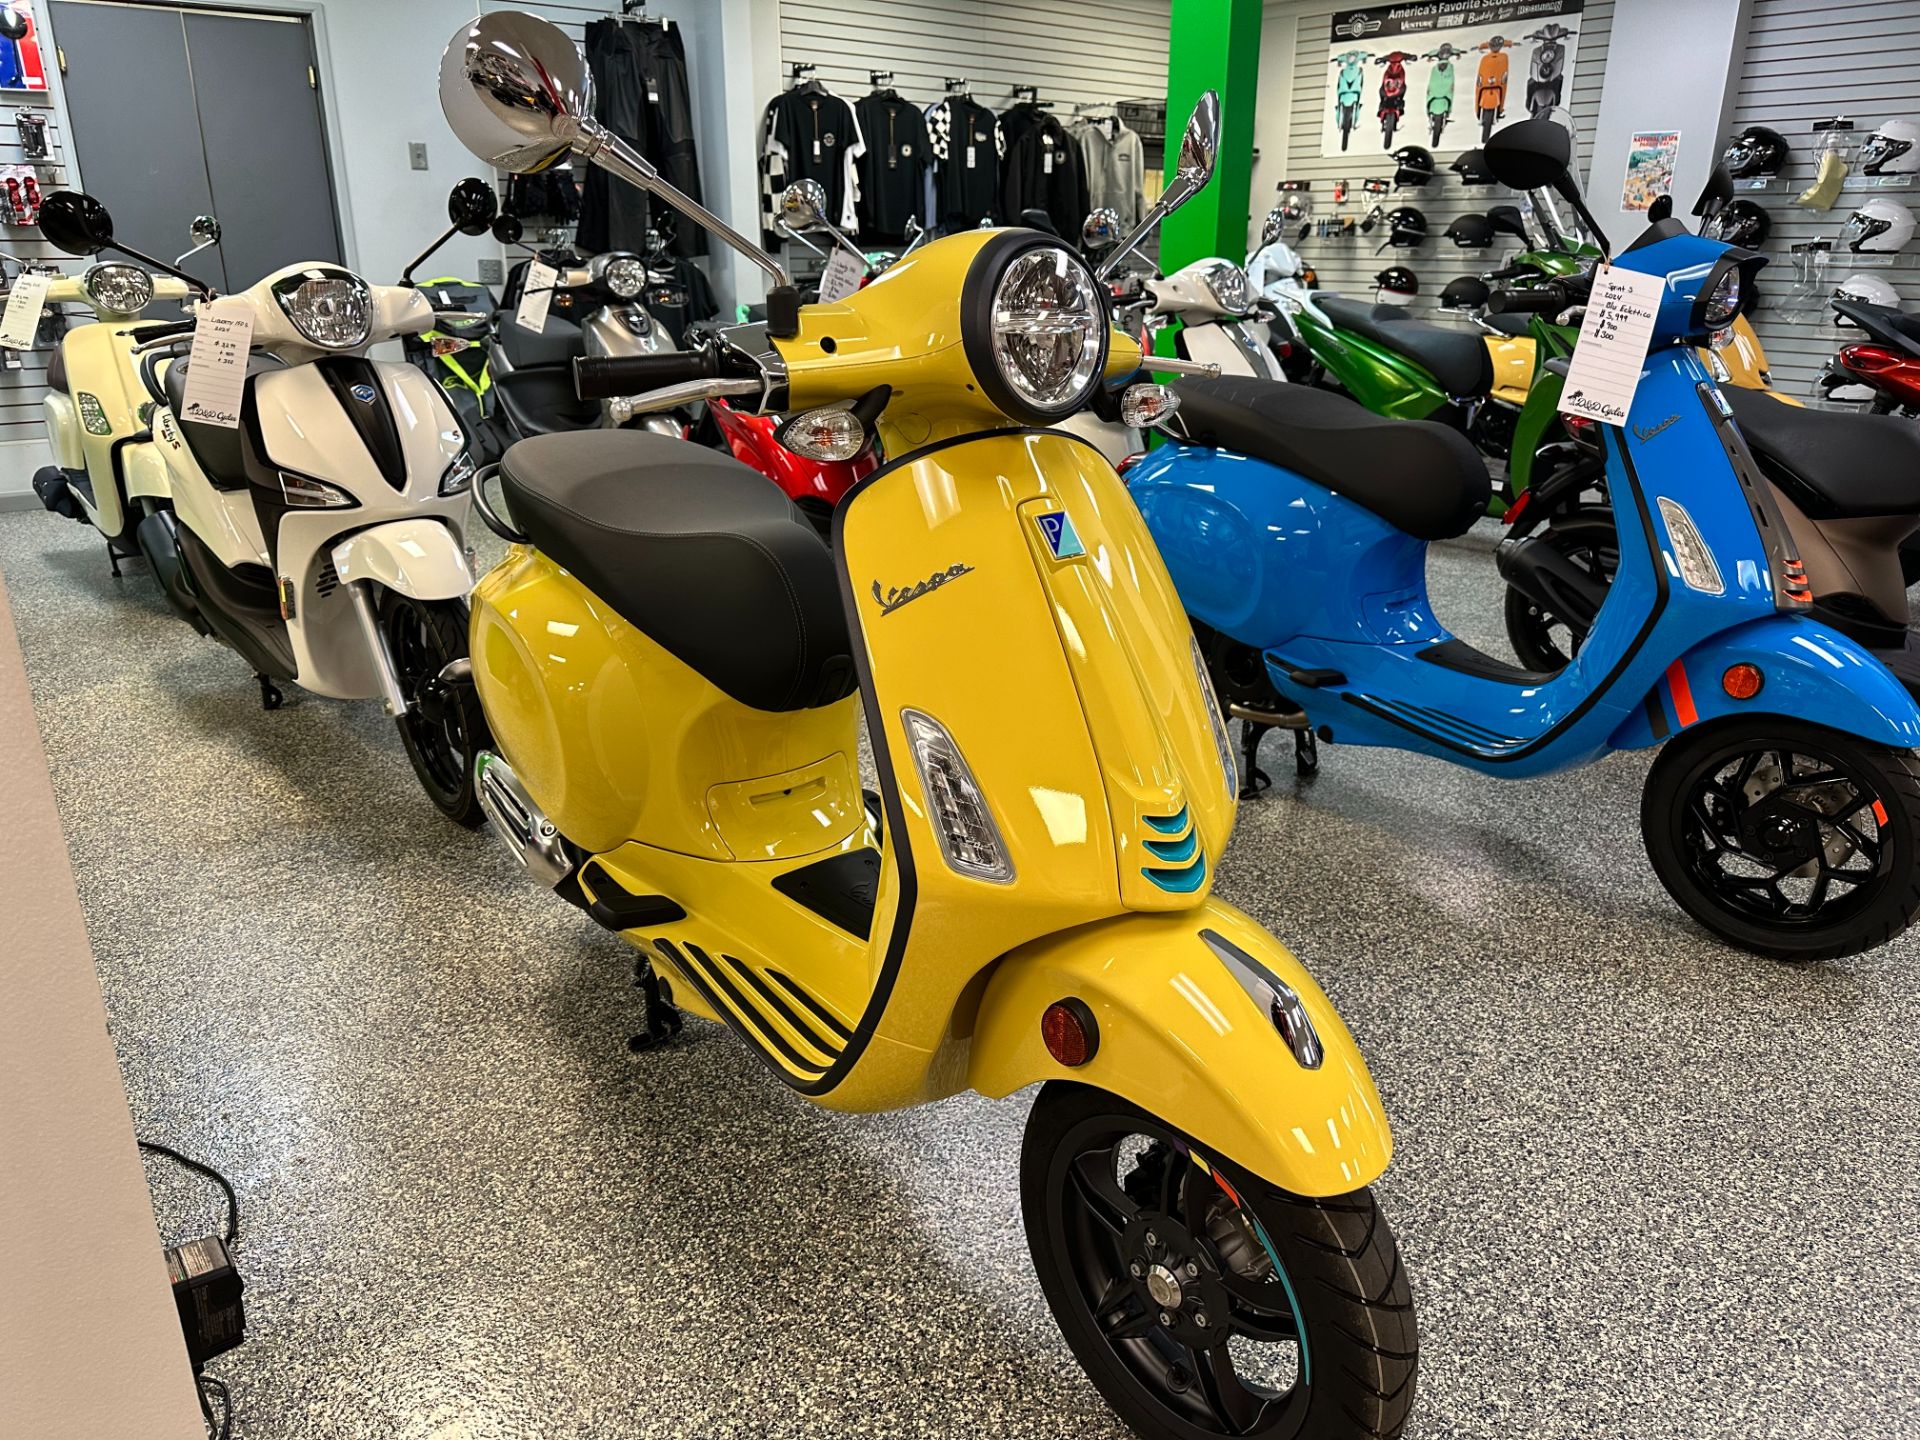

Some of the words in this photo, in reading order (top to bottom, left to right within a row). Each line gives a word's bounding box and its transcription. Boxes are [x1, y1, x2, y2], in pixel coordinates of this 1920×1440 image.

[1388, 4, 1437, 19] America's
[1439, 0, 1480, 13] Favorite
[1468, 11, 1494, 24] Buddy
[1608, 282, 1625, 292] Sprint
[1604, 292, 1622, 301] 2024
[1606, 301, 1617, 311] Blu
[1601, 404, 1625, 418] Cycles
[216, 412, 237, 422] Cycles
[451, 430, 460, 440] S
[1633, 414, 1681, 445] Vespa
[171, 441, 181, 450] S
[1041, 517, 1060, 544] P
[872, 562, 975, 617] Vespa
